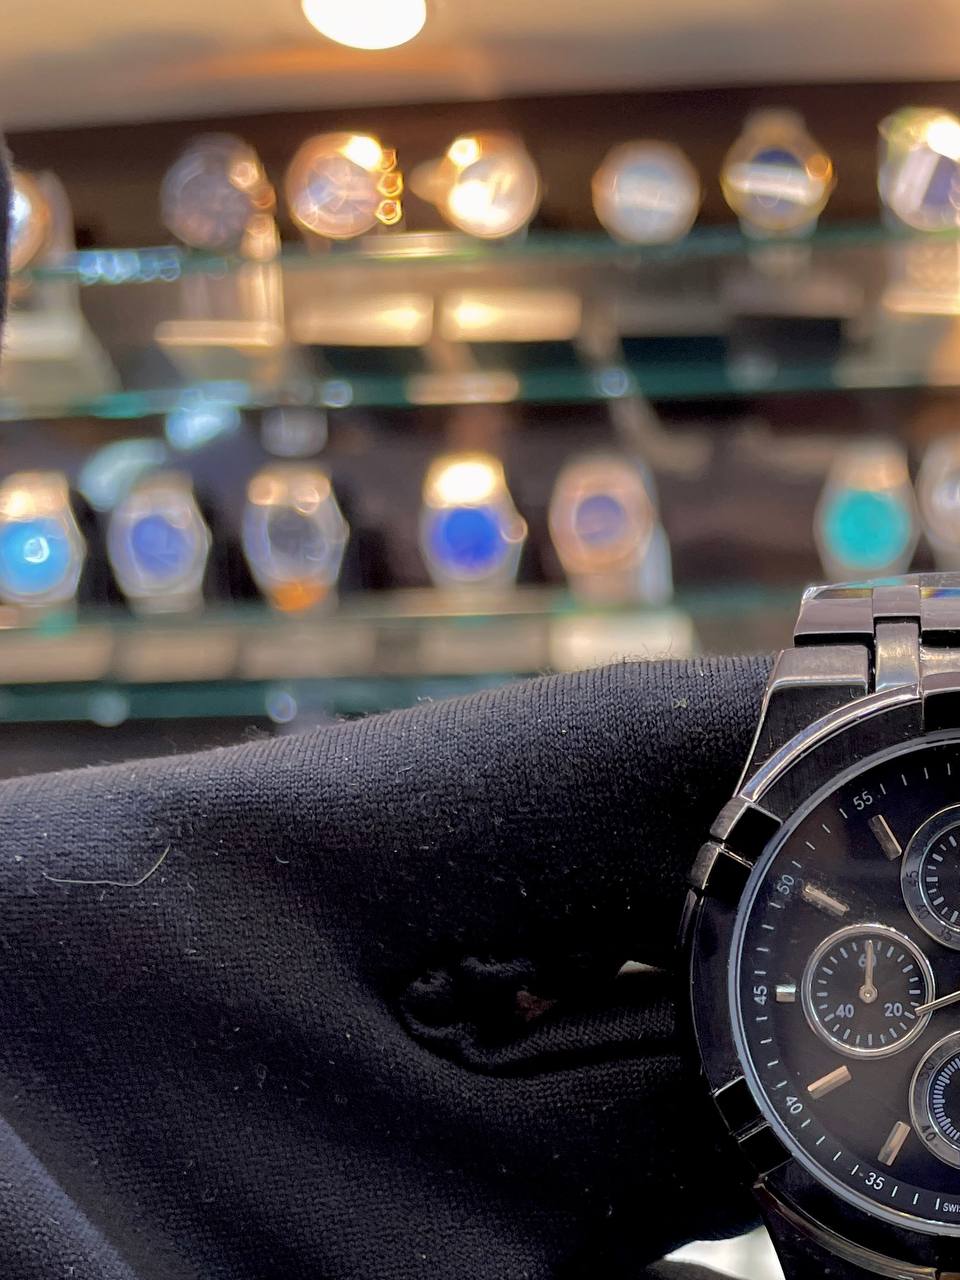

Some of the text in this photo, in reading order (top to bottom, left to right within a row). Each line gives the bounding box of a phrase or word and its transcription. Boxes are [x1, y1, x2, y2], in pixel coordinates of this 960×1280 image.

[853, 791, 873, 810] 55
[777, 874, 795, 895] 50
[753, 985, 767, 1005] 45
[835, 1004, 854, 1018] 40
[884, 1003, 903, 1017] 20
[785, 1095, 803, 1114] 40
[865, 1172, 886, 1190] 35
